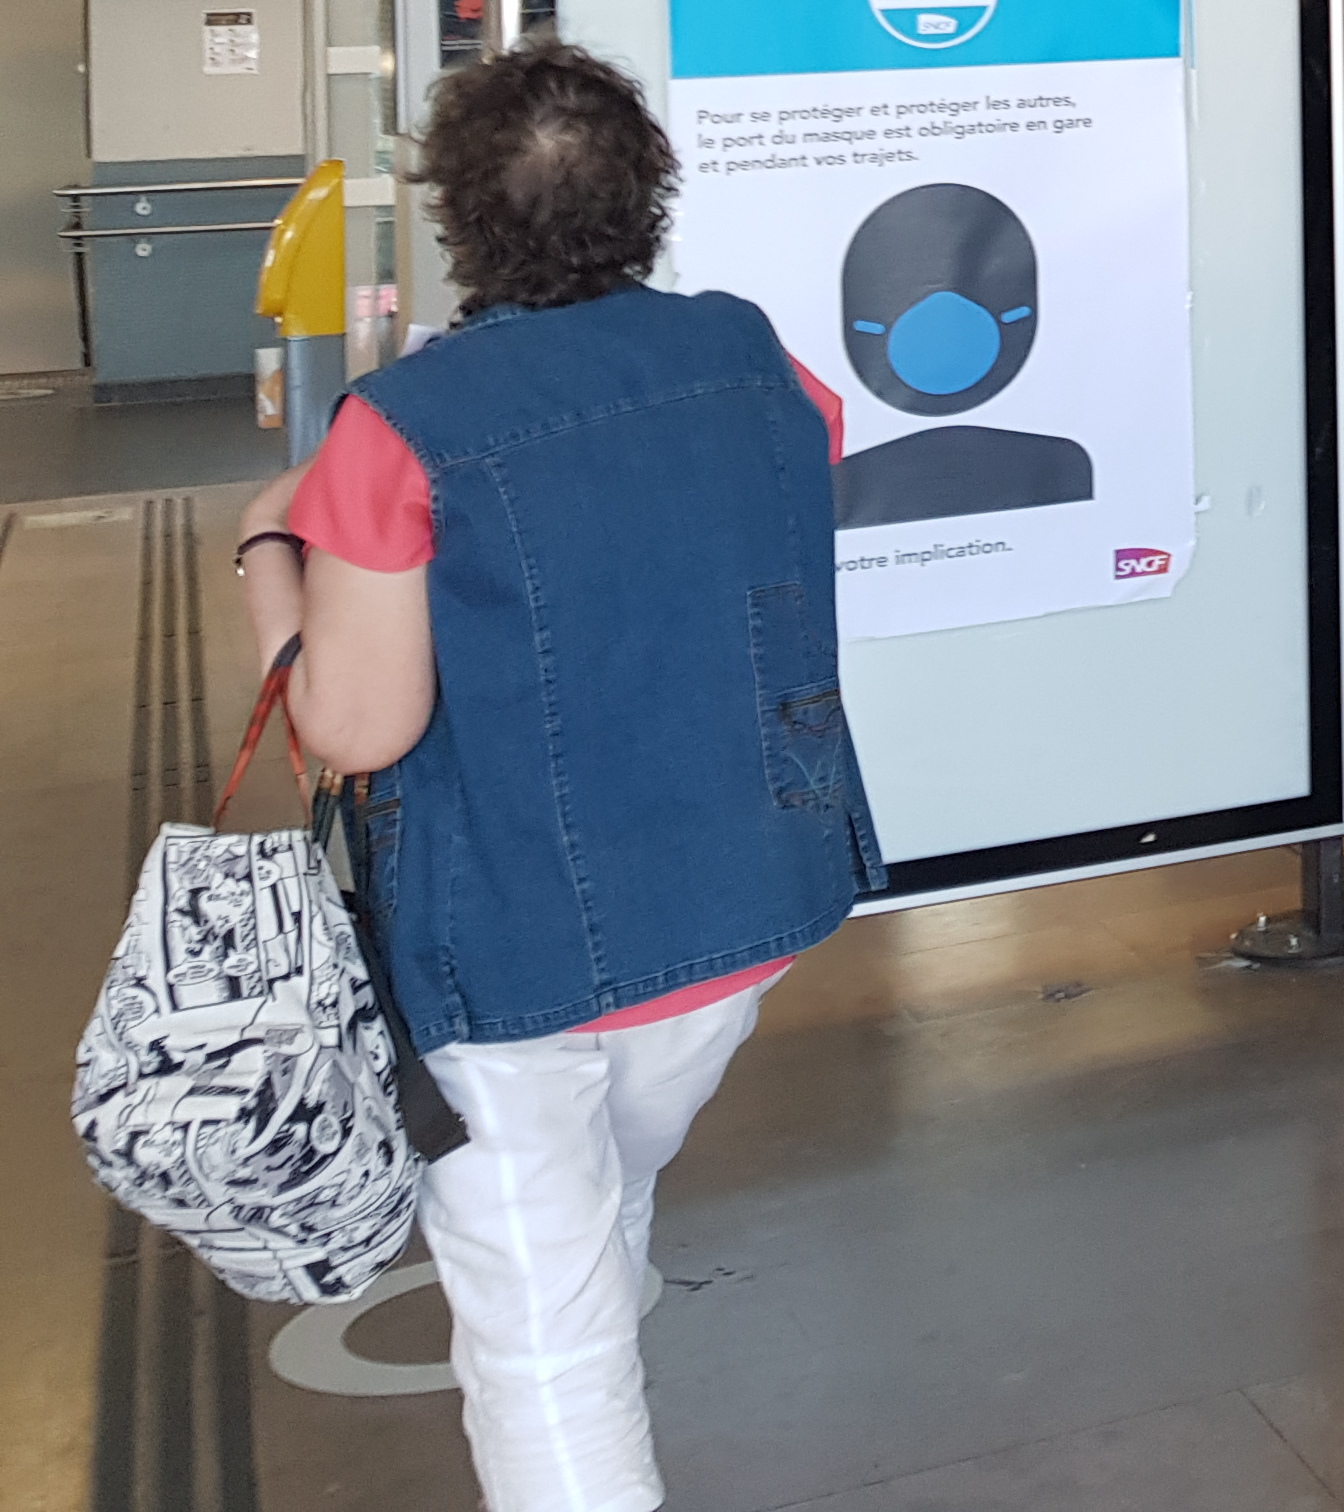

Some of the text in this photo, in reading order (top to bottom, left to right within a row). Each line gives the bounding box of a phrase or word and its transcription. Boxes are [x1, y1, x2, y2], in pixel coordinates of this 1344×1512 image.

[697, 95, 1077, 125] Pour se protéger et protéger les autres,
[697, 117, 1092, 152] le port du masque est obligatoire en gare
[698, 148, 919, 176] et pendant vos trajets.
[894, 540, 1014, 567] implication.
[1115, 554, 1169, 576] SNCF
